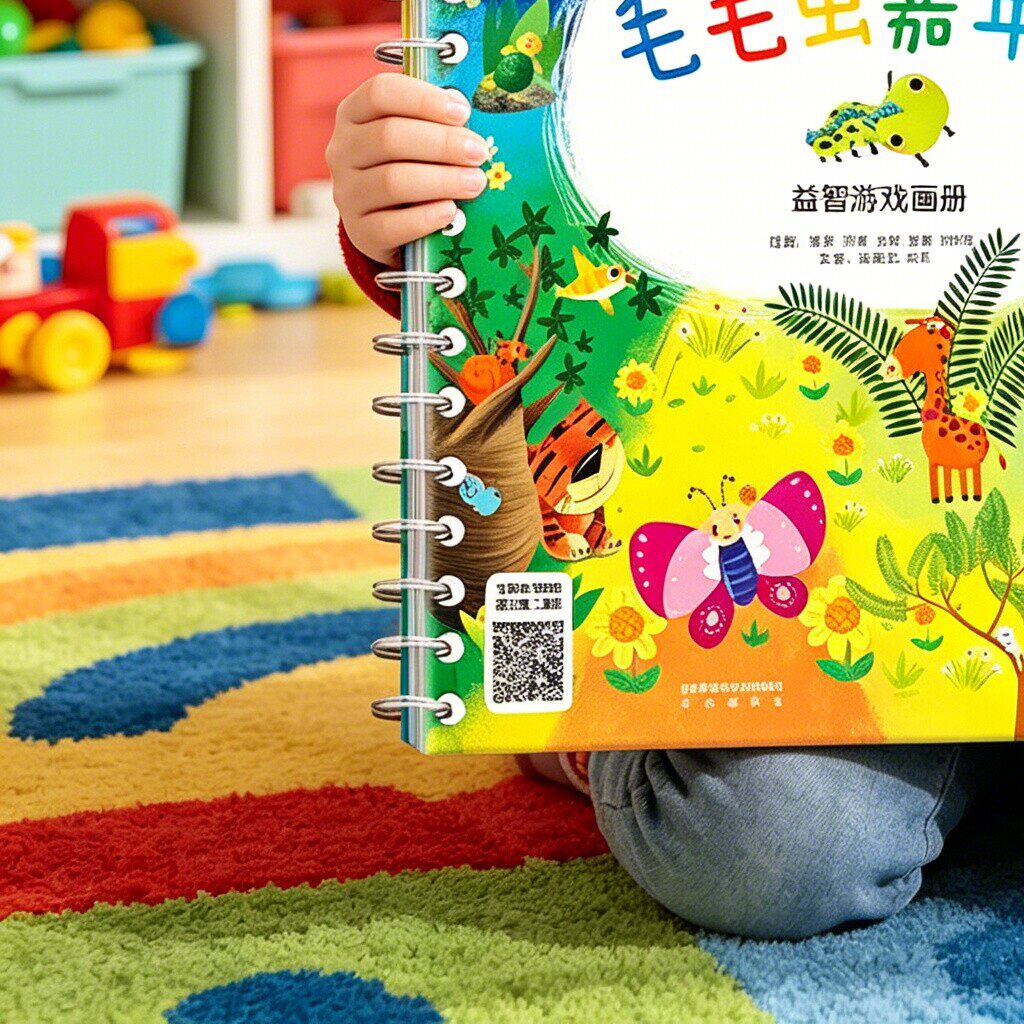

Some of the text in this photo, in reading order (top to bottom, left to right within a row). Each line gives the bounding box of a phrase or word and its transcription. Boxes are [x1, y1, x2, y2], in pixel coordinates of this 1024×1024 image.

[791, 183, 967, 214] 益智游戏画册
